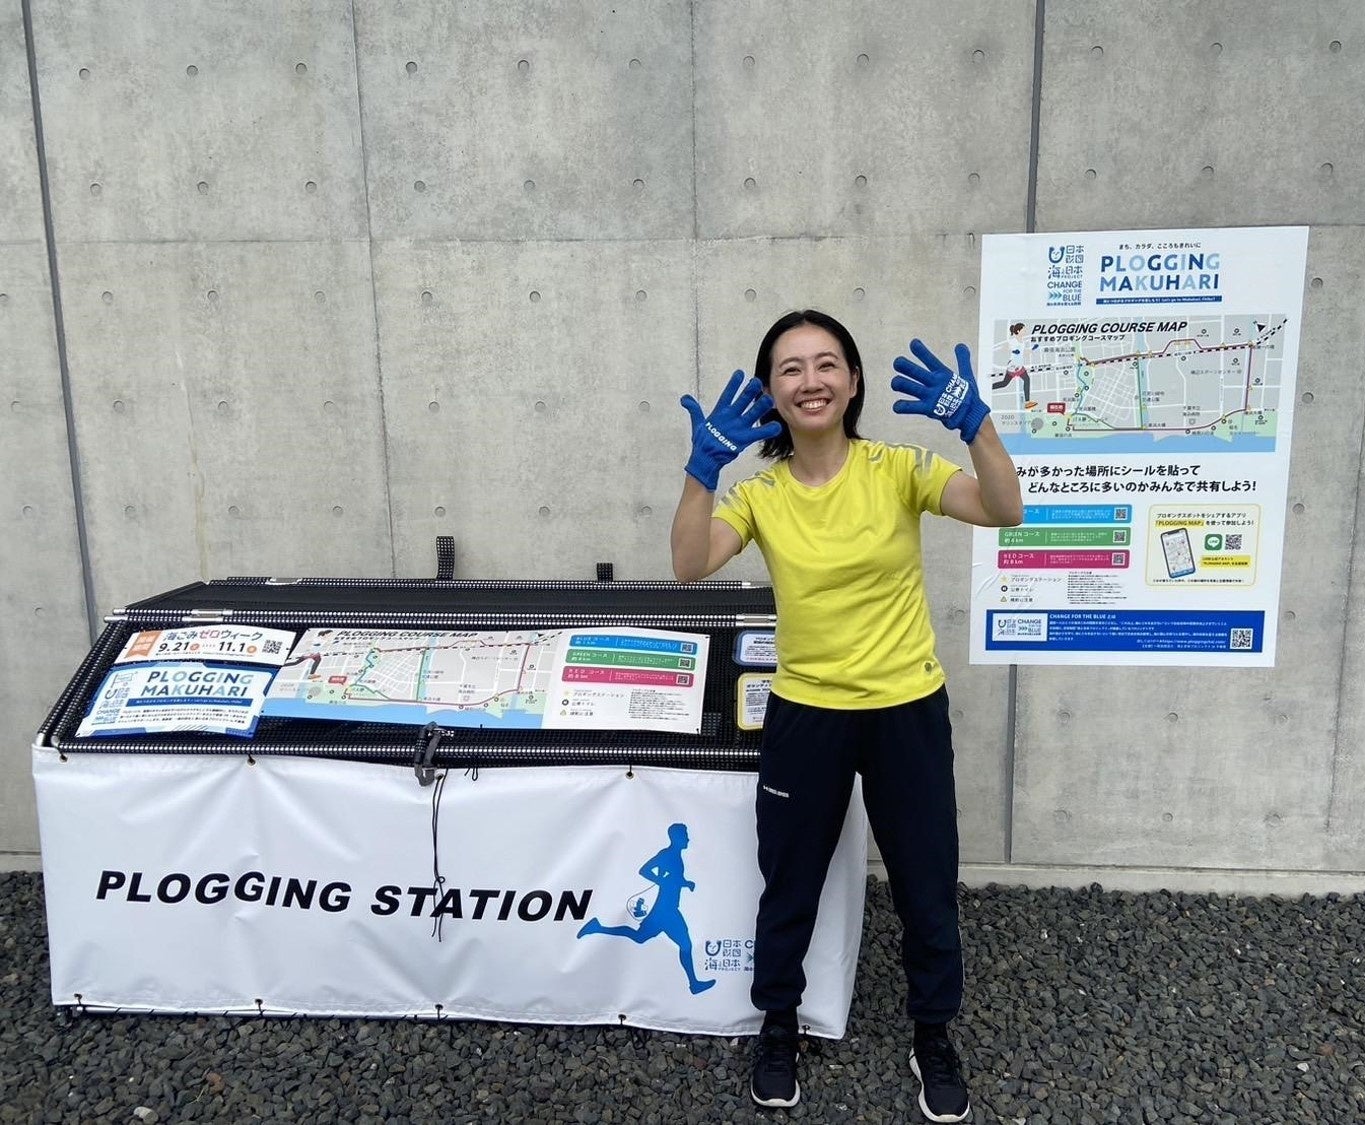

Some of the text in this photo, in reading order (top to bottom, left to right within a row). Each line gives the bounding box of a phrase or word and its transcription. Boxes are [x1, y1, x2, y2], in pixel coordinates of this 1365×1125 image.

[1066, 245, 1084, 254] 日本
[1101, 254, 1220, 272] PLOGGING
[1047, 281, 1082, 289] CHANGE
[1100, 274, 1218, 291] MAKUHARI
[1062, 293, 1082, 302] BLUE
[1031, 321, 1188, 335] PLOGGING COURSE MAP
[1030, 334, 1125, 342] おすすめプロギングコースマップ
[705, 422, 738, 451] PLOGGING
[1016, 465, 1200, 477] みが多かった場所にシールを貼って
[1028, 480, 1257, 493] どんなところに多いのかみんなで共有しよう!
[163, 629, 263, 641] 海ごみゼロウィーク
[158, 641, 189, 653] 9.21
[218, 642, 245, 652] 11.1
[147, 671, 254, 684] PLOGGING
[140, 684, 248, 697] MAKUHARI
[96, 870, 593, 922] PLOGGING STATION
[723, 940, 741, 948] 日本
